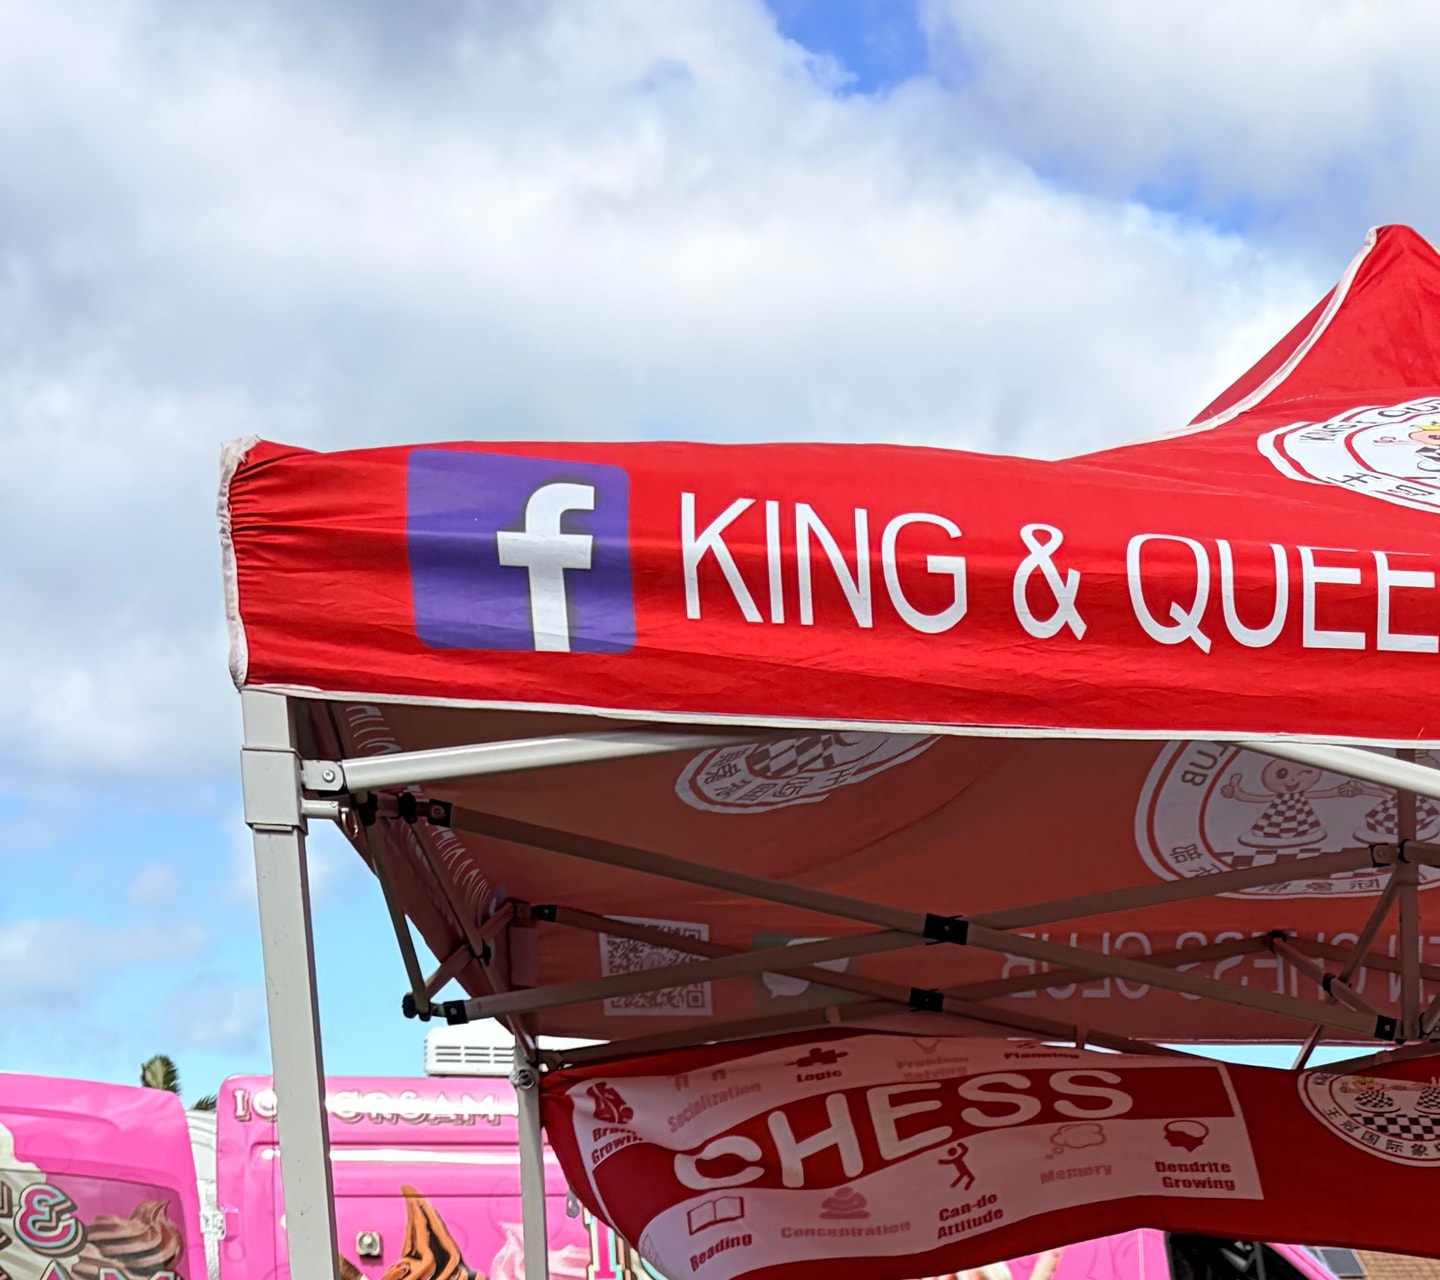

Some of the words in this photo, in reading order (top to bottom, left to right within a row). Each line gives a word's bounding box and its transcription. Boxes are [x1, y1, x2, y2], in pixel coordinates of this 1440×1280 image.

[680, 491, 967, 633] KING
[1012, 522, 1087, 641] &
[796, 1070, 842, 1084] Logic
[674, 1069, 1134, 1191] CHESS
[1040, 1164, 1113, 1185] Memory
[1155, 1160, 1232, 1174] Dendrite
[1162, 1176, 1236, 1192] Growing
[938, 1193, 999, 1221] Can-do
[780, 1219, 911, 1240] Concentration
[937, 1207, 1004, 1240] Attitude
[690, 1232, 753, 1273] Reading
